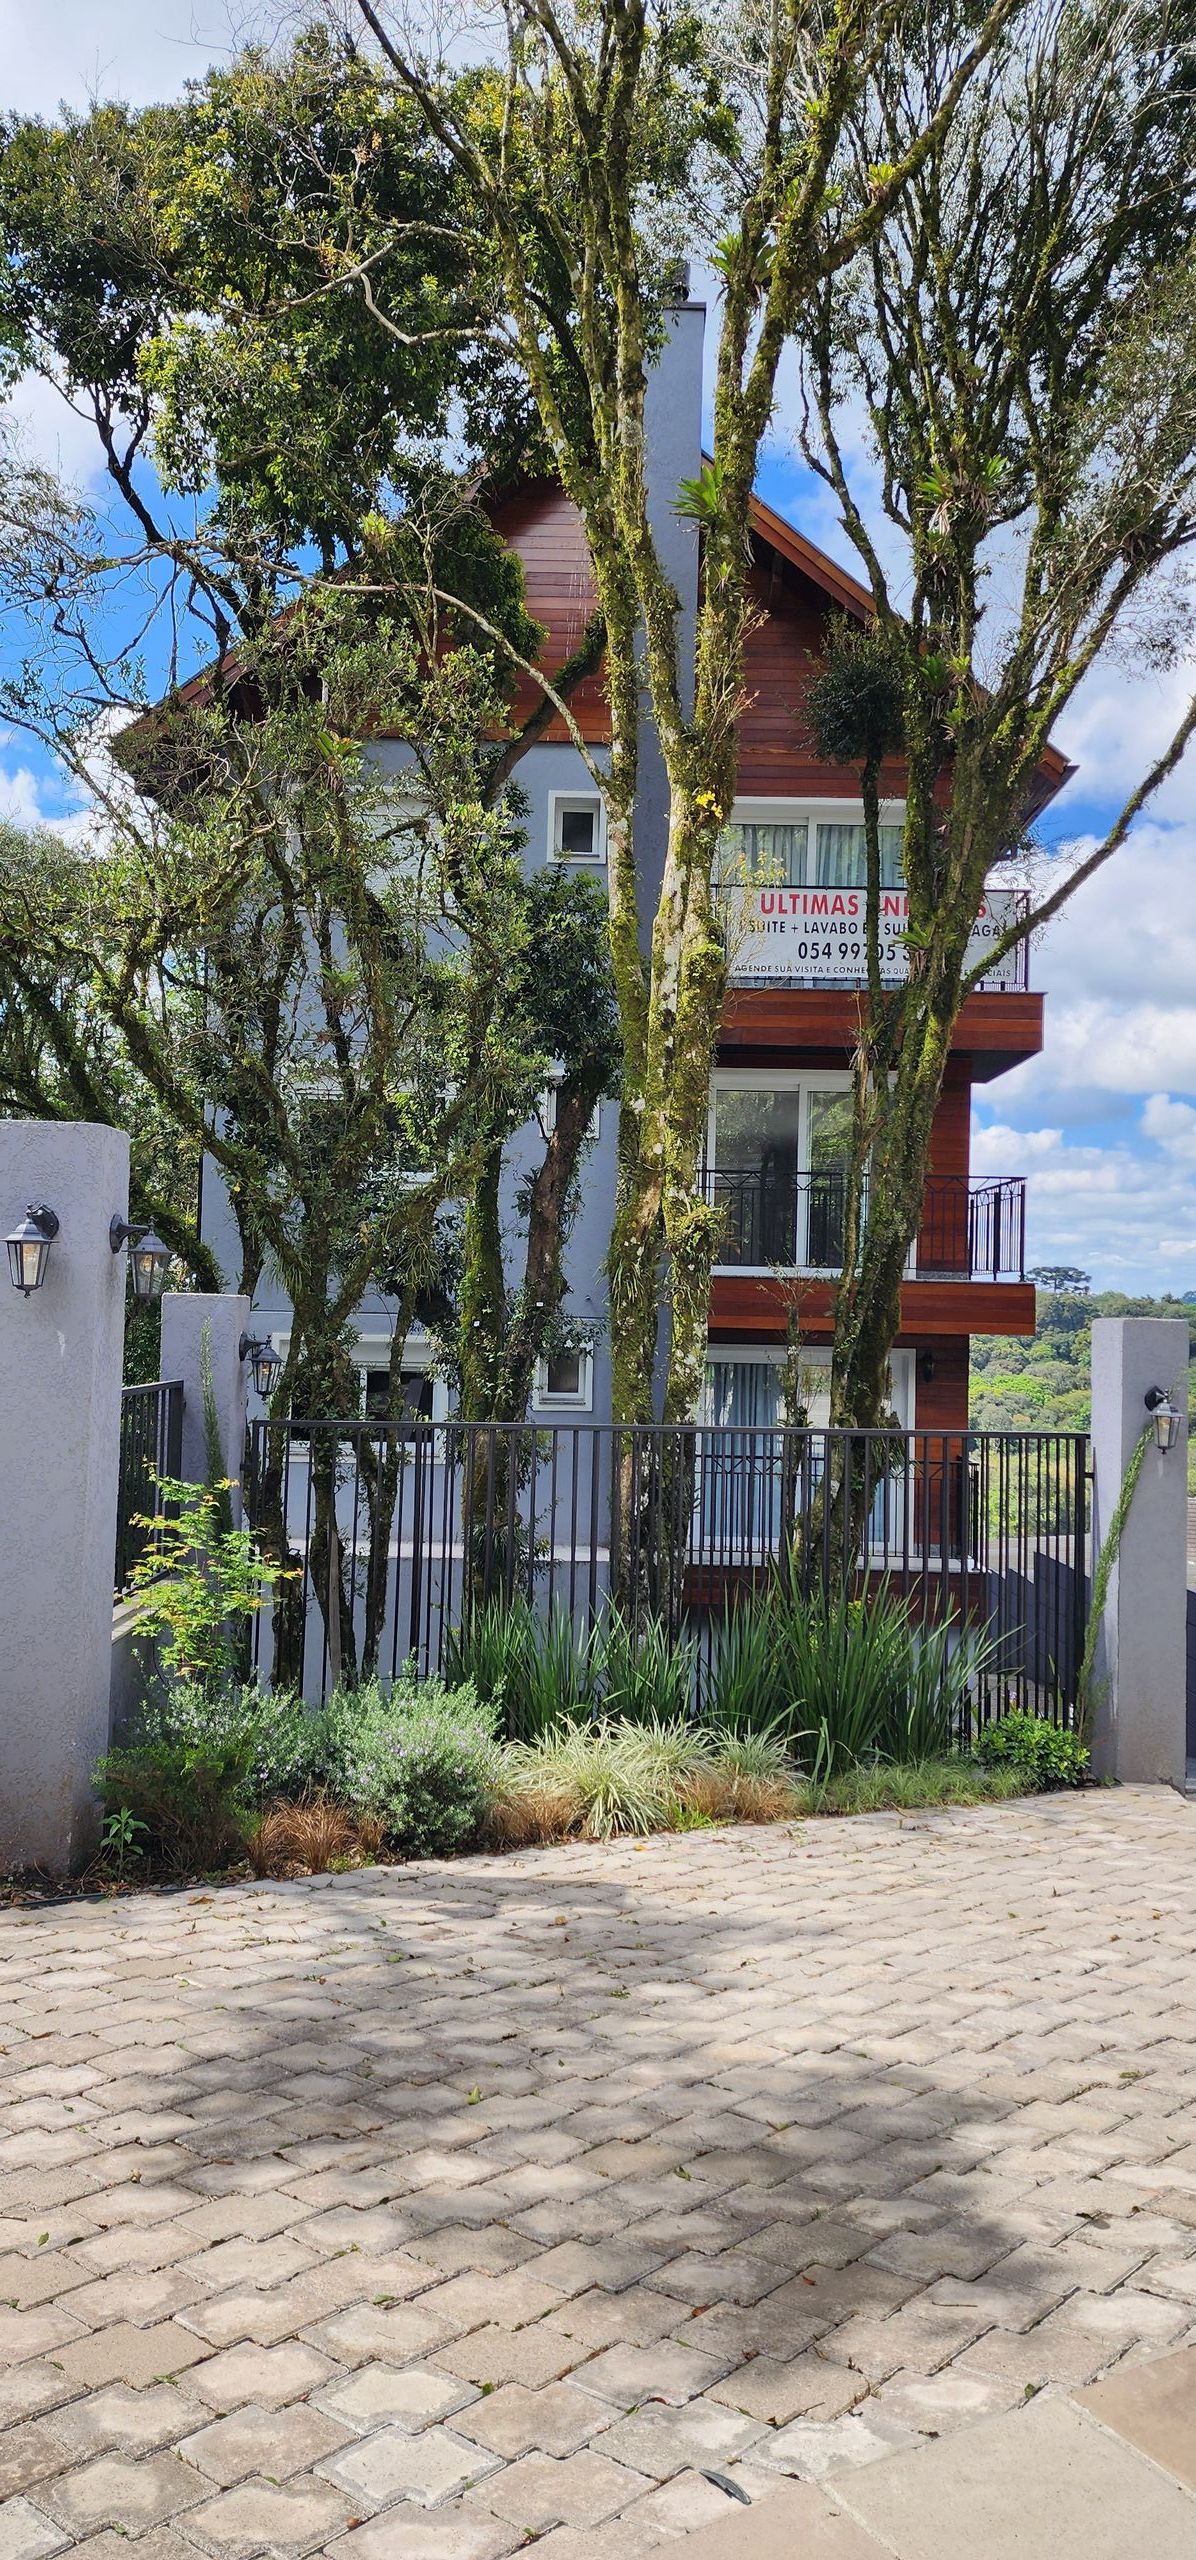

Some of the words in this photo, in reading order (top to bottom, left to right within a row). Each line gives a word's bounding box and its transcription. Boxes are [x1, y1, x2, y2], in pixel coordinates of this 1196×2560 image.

[760, 893, 859, 916] ULTIMAS
[804, 921, 858, 935] LAVABO
[798, 941, 832, 960] 054
[838, 942, 896, 961] 9905
[734, 964, 772, 973] AGENDE
[774, 965, 793, 973] SUA
[795, 965, 824, 974] VISITA
[833, 966, 867, 974] CONHE
